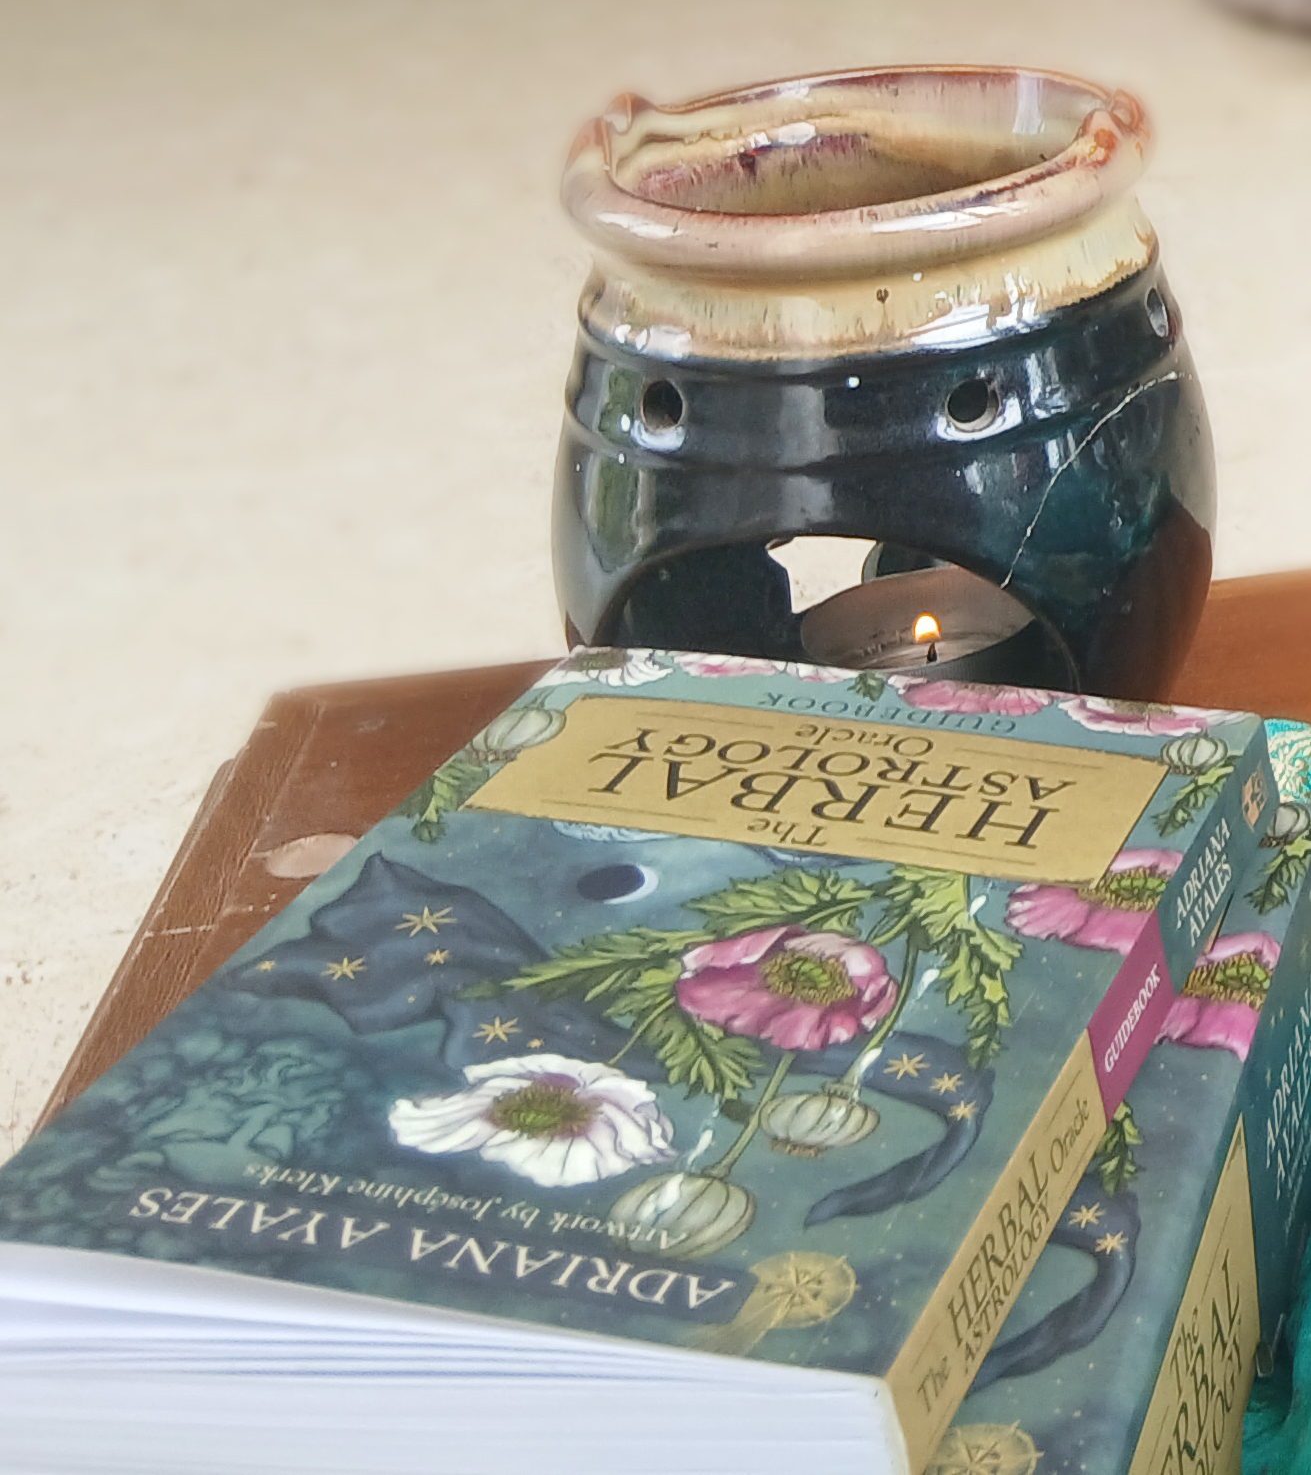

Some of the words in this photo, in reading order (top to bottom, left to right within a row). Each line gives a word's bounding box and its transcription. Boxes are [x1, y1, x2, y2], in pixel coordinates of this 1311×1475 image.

[757, 692, 1017, 735] GUIDEBOOK
[795, 724, 935, 757] Oracle
[588, 752, 1060, 849] HERBAL
[606, 727, 1077, 802] ASTROLOGY
[747, 817, 828, 847] The
[1175, 817, 1232, 931] ADRIANA
[1189, 853, 1233, 947] AYALES
[1104, 963, 1161, 1073] GUIDEBOOK
[1050, 1097, 1090, 1174] Oracle
[243, 1162, 344, 1196] Klerks
[501, 1199, 544, 1230] by
[129, 1187, 391, 1249] AYALES
[553, 1211, 688, 1252] Artwork
[947, 1151, 1050, 1346] HERBAL
[409, 1228, 735, 1310] ADRIANA
[964, 1190, 1052, 1374] ASTROLOGY
[916, 1355, 949, 1413] The
[1170, 1305, 1199, 1401] The
